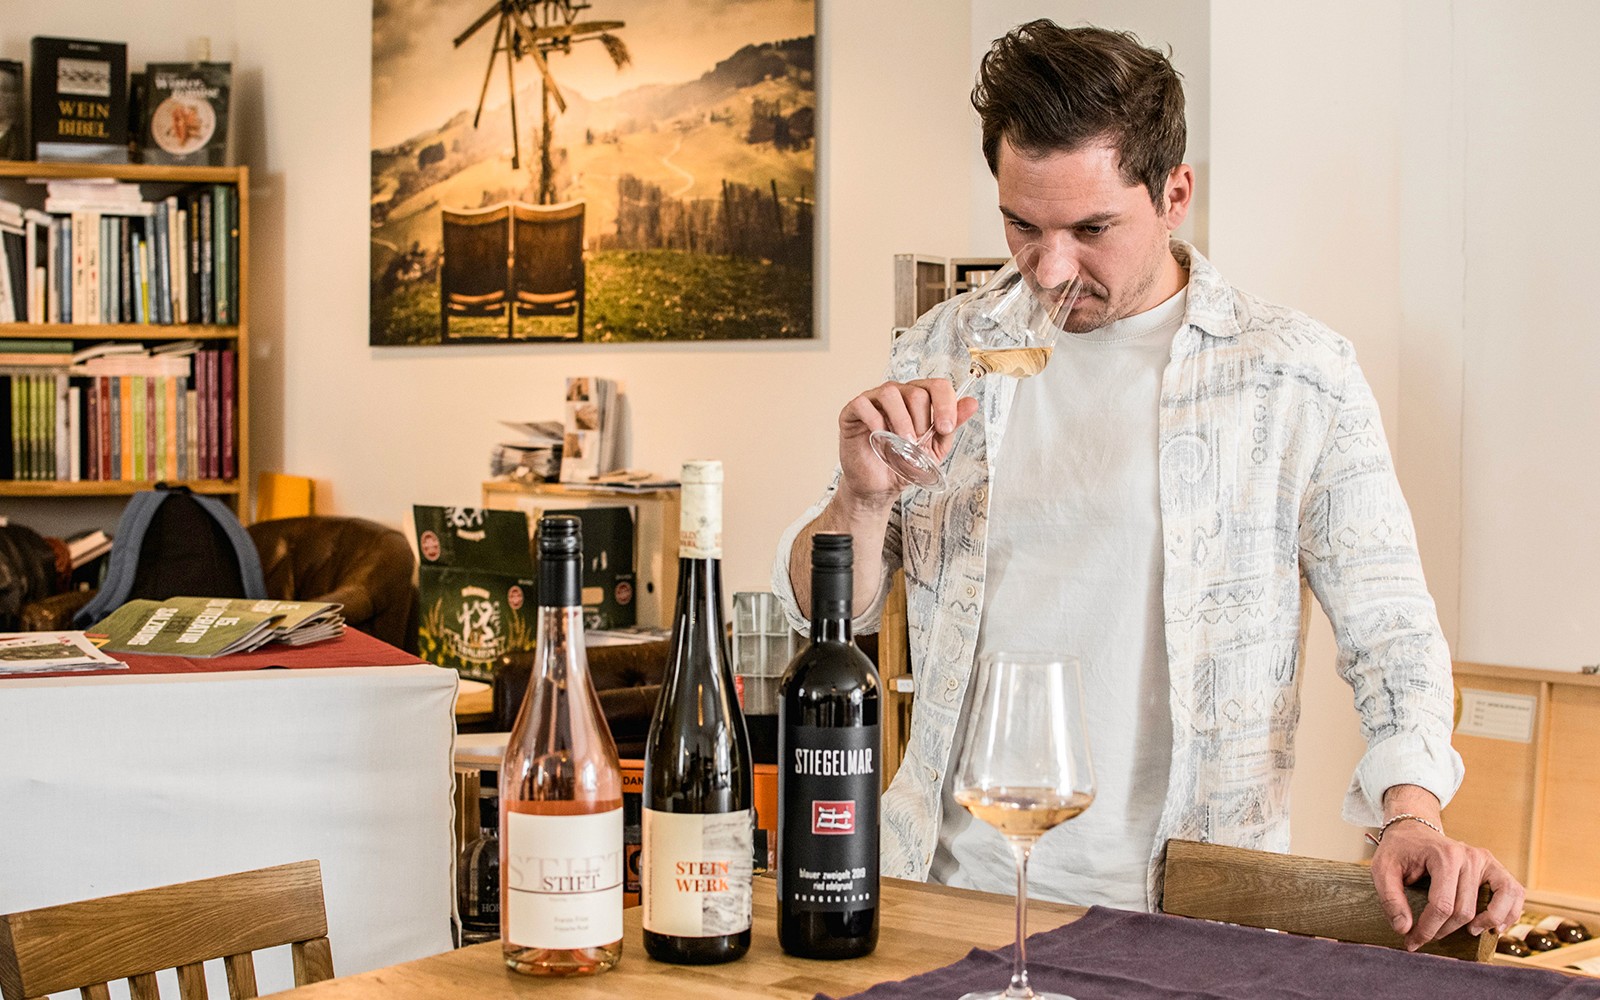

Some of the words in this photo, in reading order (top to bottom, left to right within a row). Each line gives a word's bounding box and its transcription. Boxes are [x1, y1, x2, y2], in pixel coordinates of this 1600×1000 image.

[57, 99, 110, 119] WEIN
[57, 117, 110, 138] BIBEL
[127, 607, 179, 646] SALZBURG
[795, 747, 874, 776] STIEGELMAR
[510, 850, 622, 889] STIFT
[675, 861, 731, 875] STEIN
[542, 875, 600, 892] STIFT
[675, 878, 730, 893] WERK
[795, 892, 870, 903] BURGENLAND
